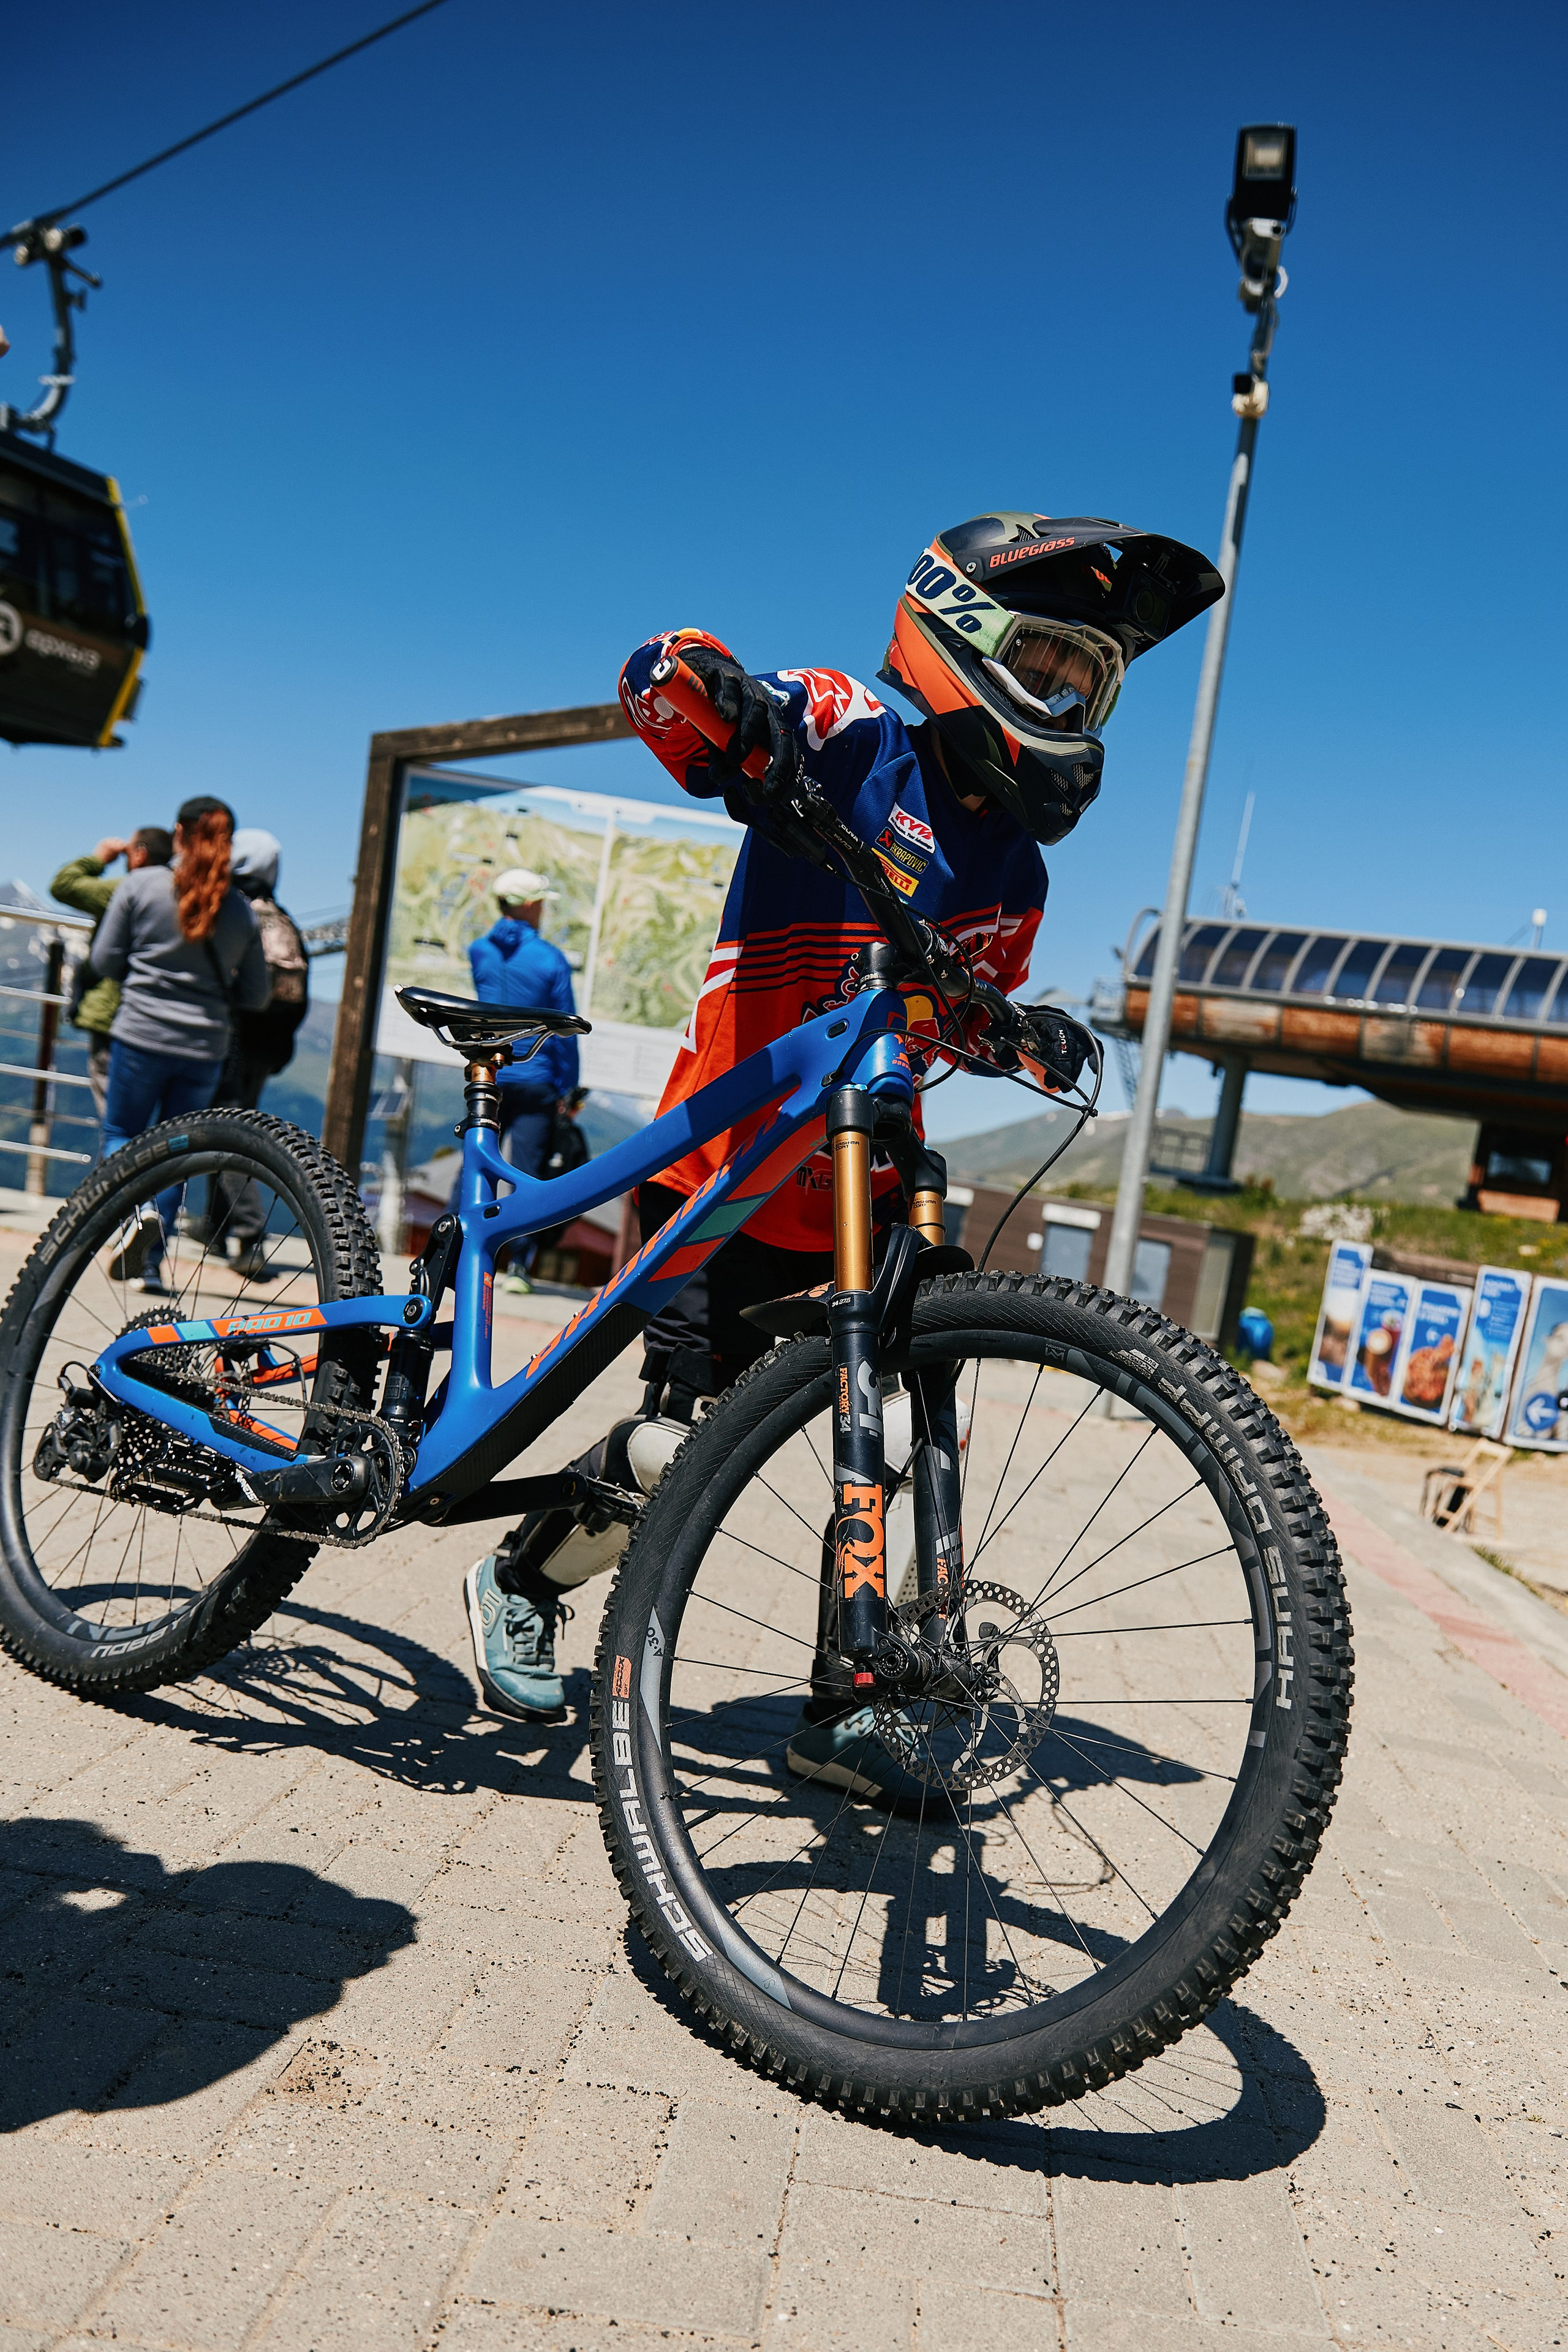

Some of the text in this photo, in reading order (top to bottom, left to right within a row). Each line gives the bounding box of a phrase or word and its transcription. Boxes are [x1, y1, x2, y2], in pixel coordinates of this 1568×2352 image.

[907, 551, 997, 634] 00%
[895, 811, 933, 840] KYB
[1058, 1029, 1068, 1054] TOUCH
[227, 1311, 312, 1333] PRO 10
[1144, 1356, 1158, 1368] EVO
[840, 1367, 850, 1415] FACTORY
[835, 1483, 885, 1599] FOX
[1157, 1377, 1294, 1710] HANS DAMPF
[612, 1700, 718, 1962] SCHWALBE
[657, 1802, 679, 1859] EVOLUTION
